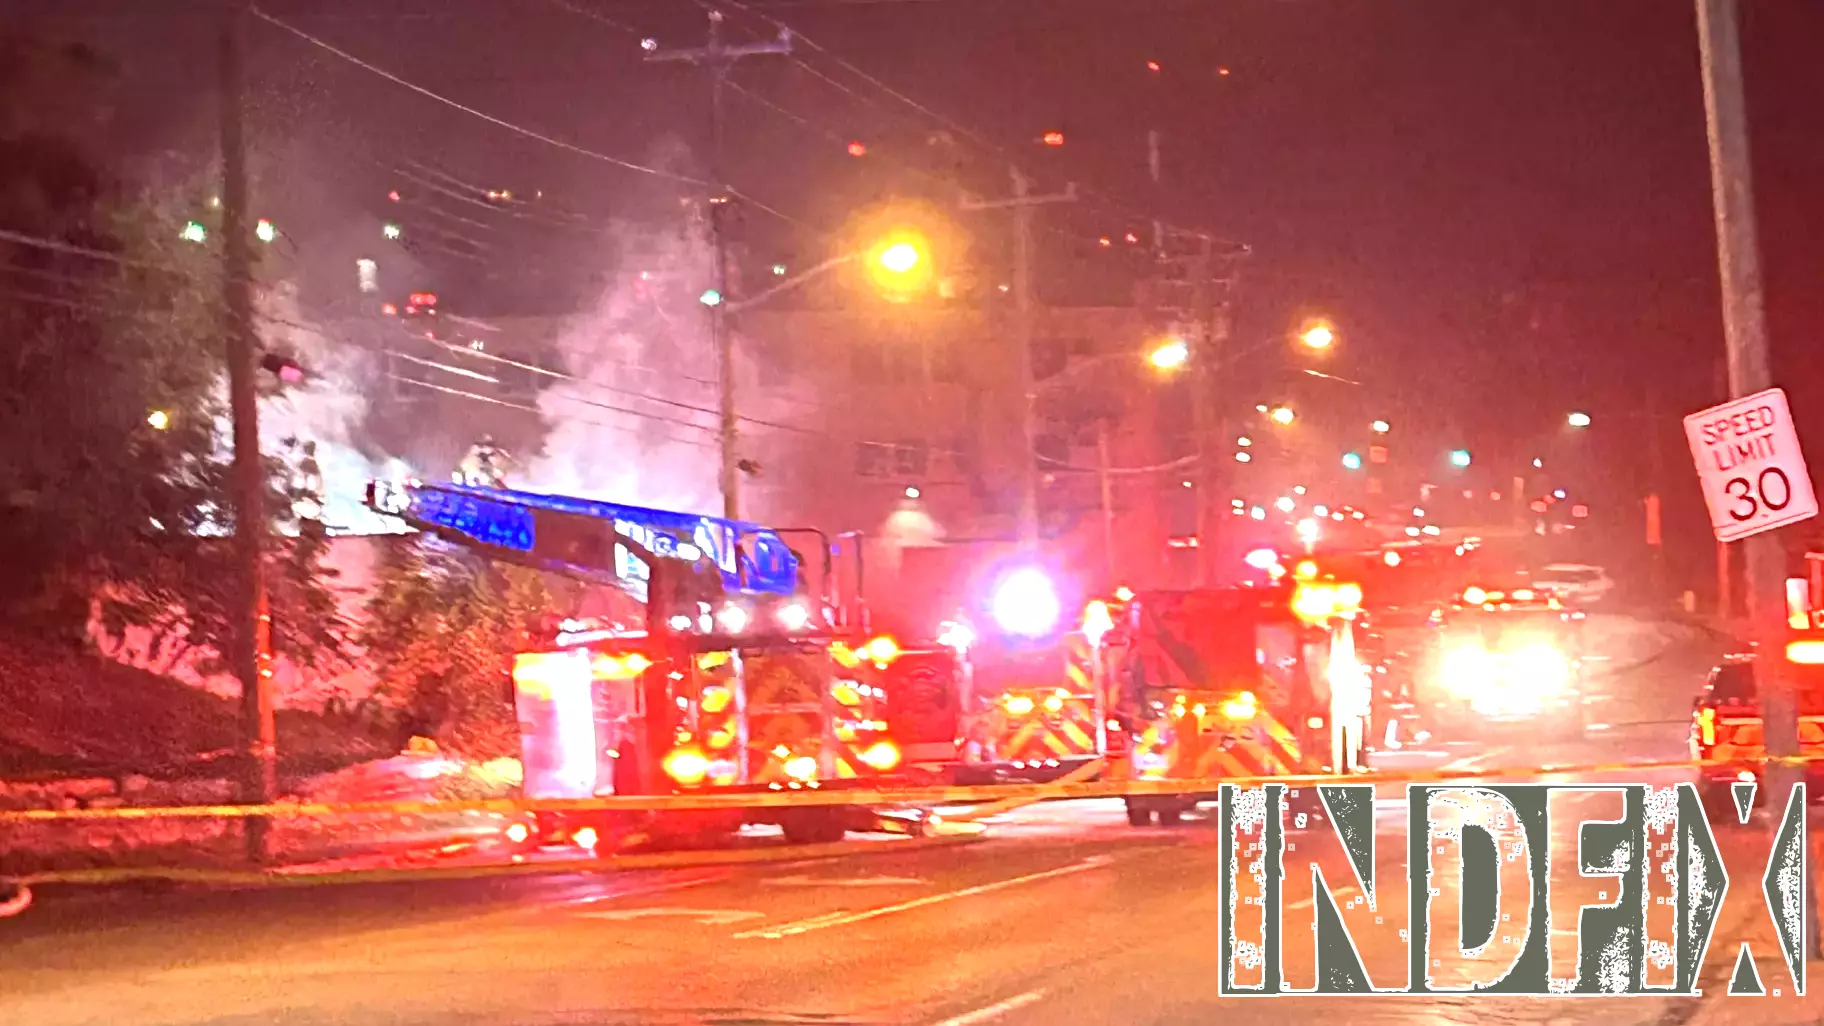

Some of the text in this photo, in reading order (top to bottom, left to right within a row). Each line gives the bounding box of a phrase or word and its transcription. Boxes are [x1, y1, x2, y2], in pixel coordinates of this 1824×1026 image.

[1702, 405, 1776, 445] SPEED
[1713, 433, 1776, 472] LIMIT
[1725, 466, 1791, 521] 30
